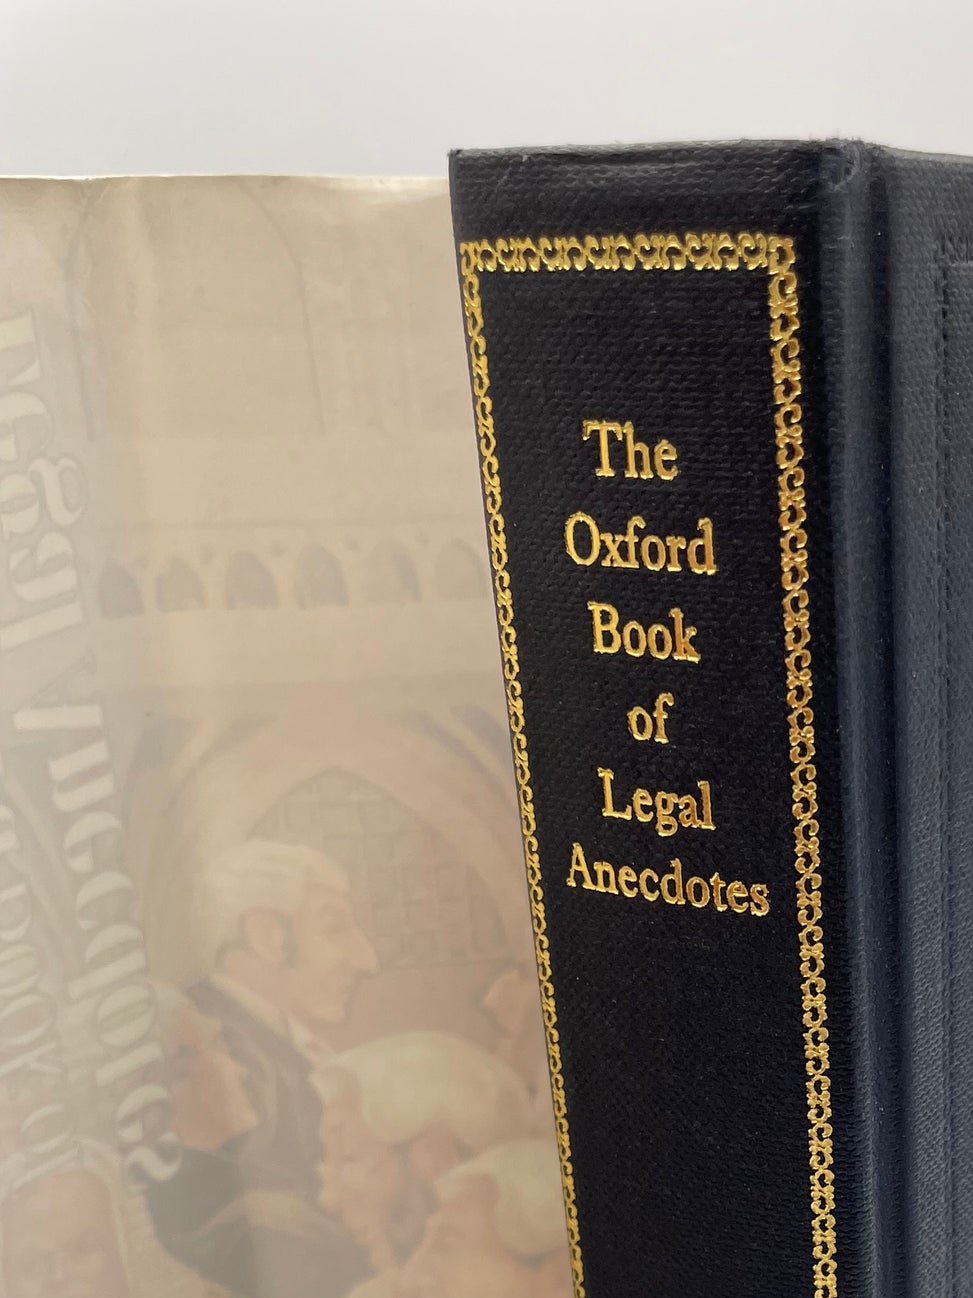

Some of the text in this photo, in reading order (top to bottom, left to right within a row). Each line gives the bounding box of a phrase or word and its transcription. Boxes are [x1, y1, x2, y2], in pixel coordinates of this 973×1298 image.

[581, 419, 679, 481] The
[564, 511, 718, 576] Oxford
[587, 600, 701, 664] Book
[627, 691, 675, 744] of
[597, 767, 716, 837] Legal
[566, 842, 770, 916] Anecdotes
